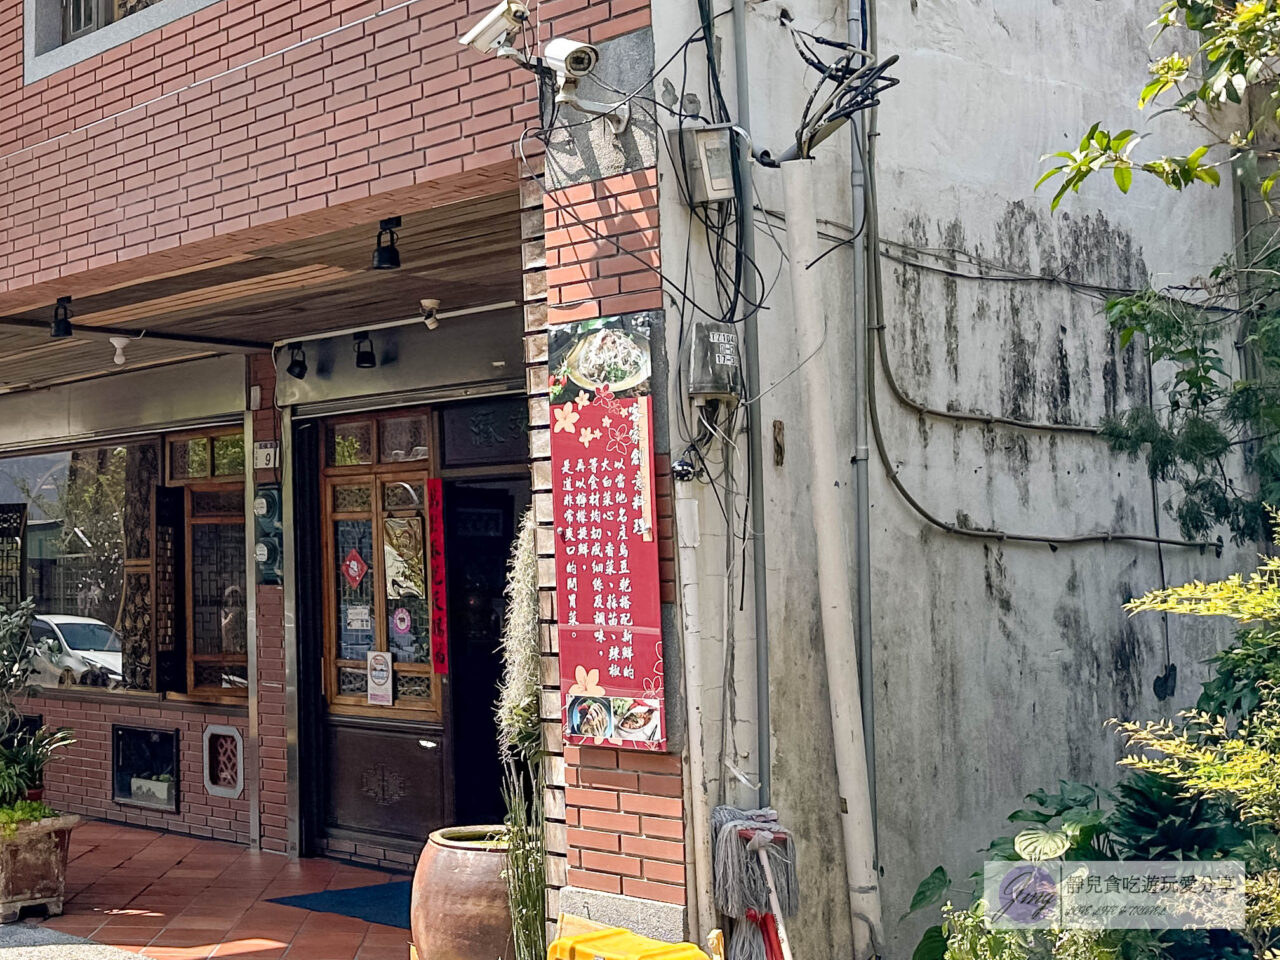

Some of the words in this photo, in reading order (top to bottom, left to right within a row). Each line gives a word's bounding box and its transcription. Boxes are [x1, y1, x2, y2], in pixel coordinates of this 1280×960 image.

[265, 453, 271, 466] 9
[628, 402, 650, 535] 客家創意料理
